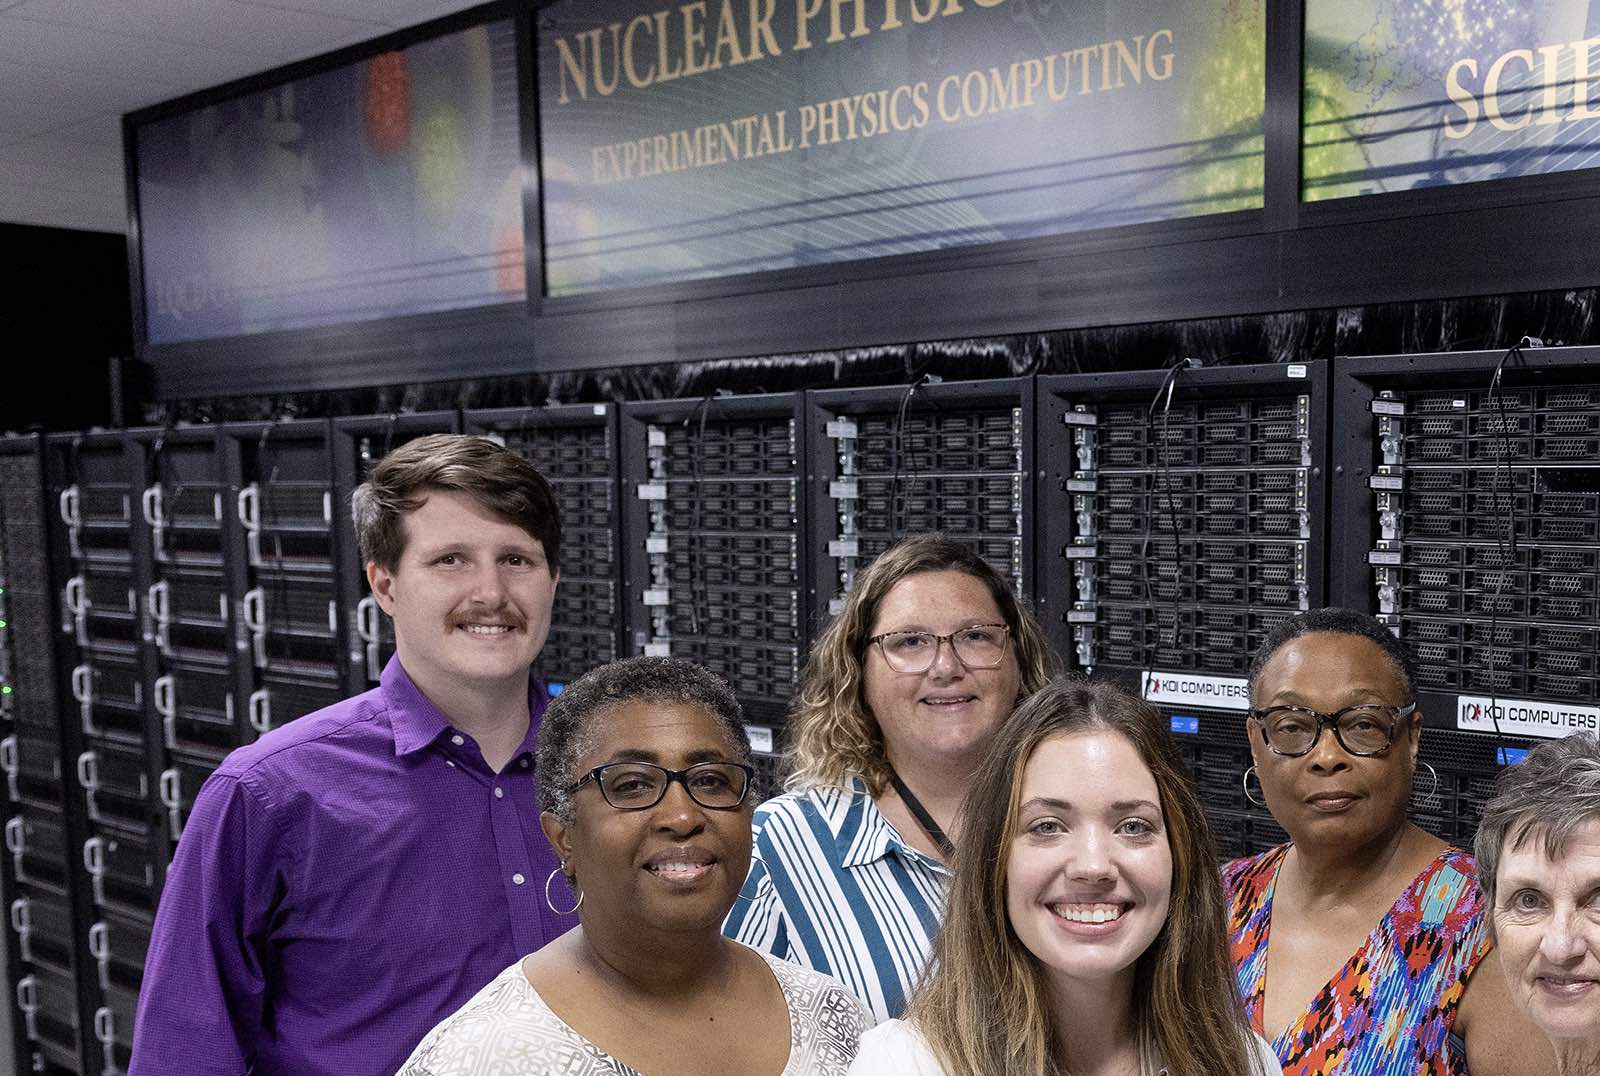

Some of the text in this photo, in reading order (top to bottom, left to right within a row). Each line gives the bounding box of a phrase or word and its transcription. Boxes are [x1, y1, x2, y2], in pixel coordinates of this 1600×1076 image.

[554, 0, 772, 105] NUCLEAR
[591, 29, 1176, 184] EXPERIMENTAL PHYSICS COMPUTING
[1162, 680, 1248, 698] KOI COMPUTERS
[1484, 705, 1505, 720] KOI
[1508, 707, 1597, 729] COMPUTERS
